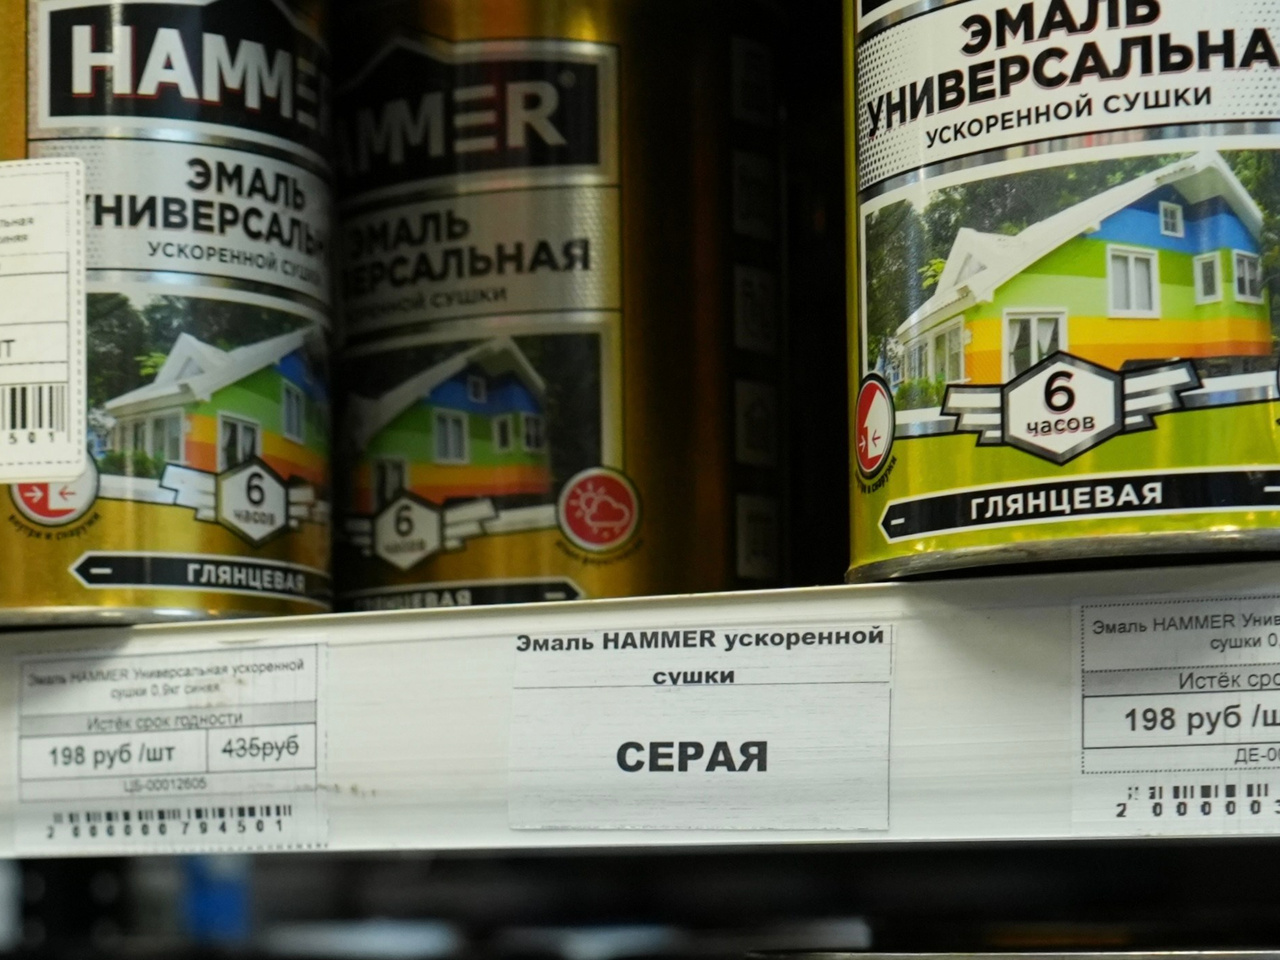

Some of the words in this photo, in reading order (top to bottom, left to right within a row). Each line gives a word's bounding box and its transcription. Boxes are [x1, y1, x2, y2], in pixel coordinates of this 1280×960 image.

[960, 0, 1161, 56] ЭМАЛЬ
[925, 93, 1093, 149] УСКОРЕННОЙ
[1103, 86, 1213, 114] СУШКИ
[186, 157, 306, 211] ЭМАЛЬ
[147, 241, 277, 272] УСКОРЕННОЙ
[1043, 370, 1076, 413] 6
[1026, 416, 1096, 437] часов
[245, 472, 266, 506] 6
[970, 481, 1163, 521] ГЛЯНЦЕВАЯ
[393, 503, 414, 537] 6
[186, 562, 306, 594] ГЛЯНЦЕВАЯ
[515, 634, 595, 653] Эмаль
[602, 629, 717, 650] HAMMER
[723, 625, 885, 652] ускоренной
[1092, 620, 1148, 635] Эмаль
[1152, 613, 1237, 632] HAMMER
[1209, 635, 1262, 653] сушки
[27, 671, 67, 688] Эмаль
[71, 668, 129, 684] HAMMER
[132, 661, 228, 681] Универсальная
[231, 658, 305, 677] ускоренной
[652, 668, 736, 686] сушки
[1178, 671, 1242, 691] Истёк
[110, 687, 148, 701] сушки
[184, 681, 220, 695] синяя
[86, 715, 133, 732] Истёк
[135, 716, 171, 732] срок
[174, 711, 244, 729] годности
[1124, 706, 1177, 732] 198
[1186, 703, 1242, 736] руб
[49, 745, 86, 767] 198
[93, 743, 132, 770] руб
[138, 744, 176, 764] /шт
[221, 735, 300, 762] 435руб
[616, 739, 769, 774] СЕРАЯ
